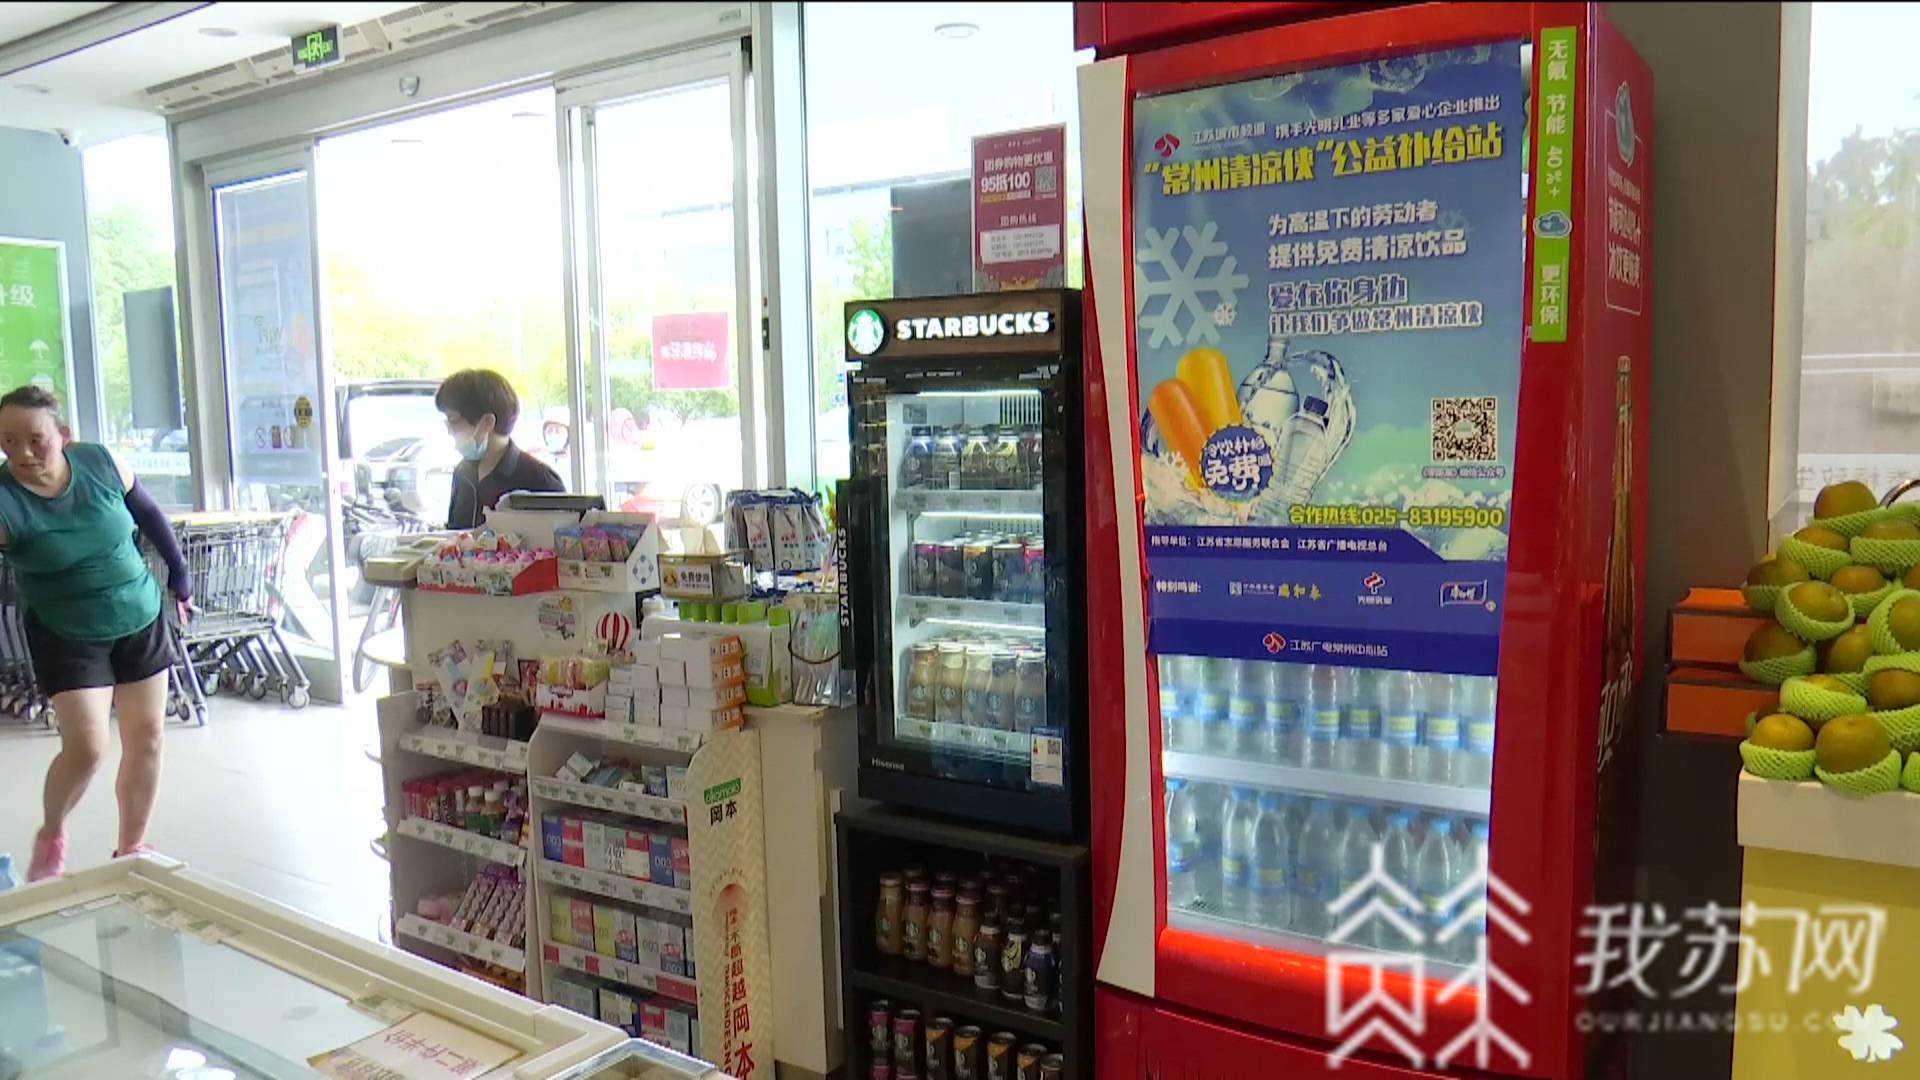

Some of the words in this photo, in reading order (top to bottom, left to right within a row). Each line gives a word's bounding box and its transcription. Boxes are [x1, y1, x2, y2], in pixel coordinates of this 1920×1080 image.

[1268, 199, 1438, 236] 为高温下的劳动者
[1268, 228, 1467, 269] 提供免费清凉饮品
[1268, 273, 1408, 312] 爱在你身边
[1539, 263, 1561, 325] 更环保
[896, 311, 1050, 341] STARBUCKS
[1268, 301, 1483, 337] 让我们争做常州清凉侠
[1205, 453, 1261, 491] 免费
[837, 527, 849, 627] STARBUCKS
[870, 756, 905, 771] Hisense
